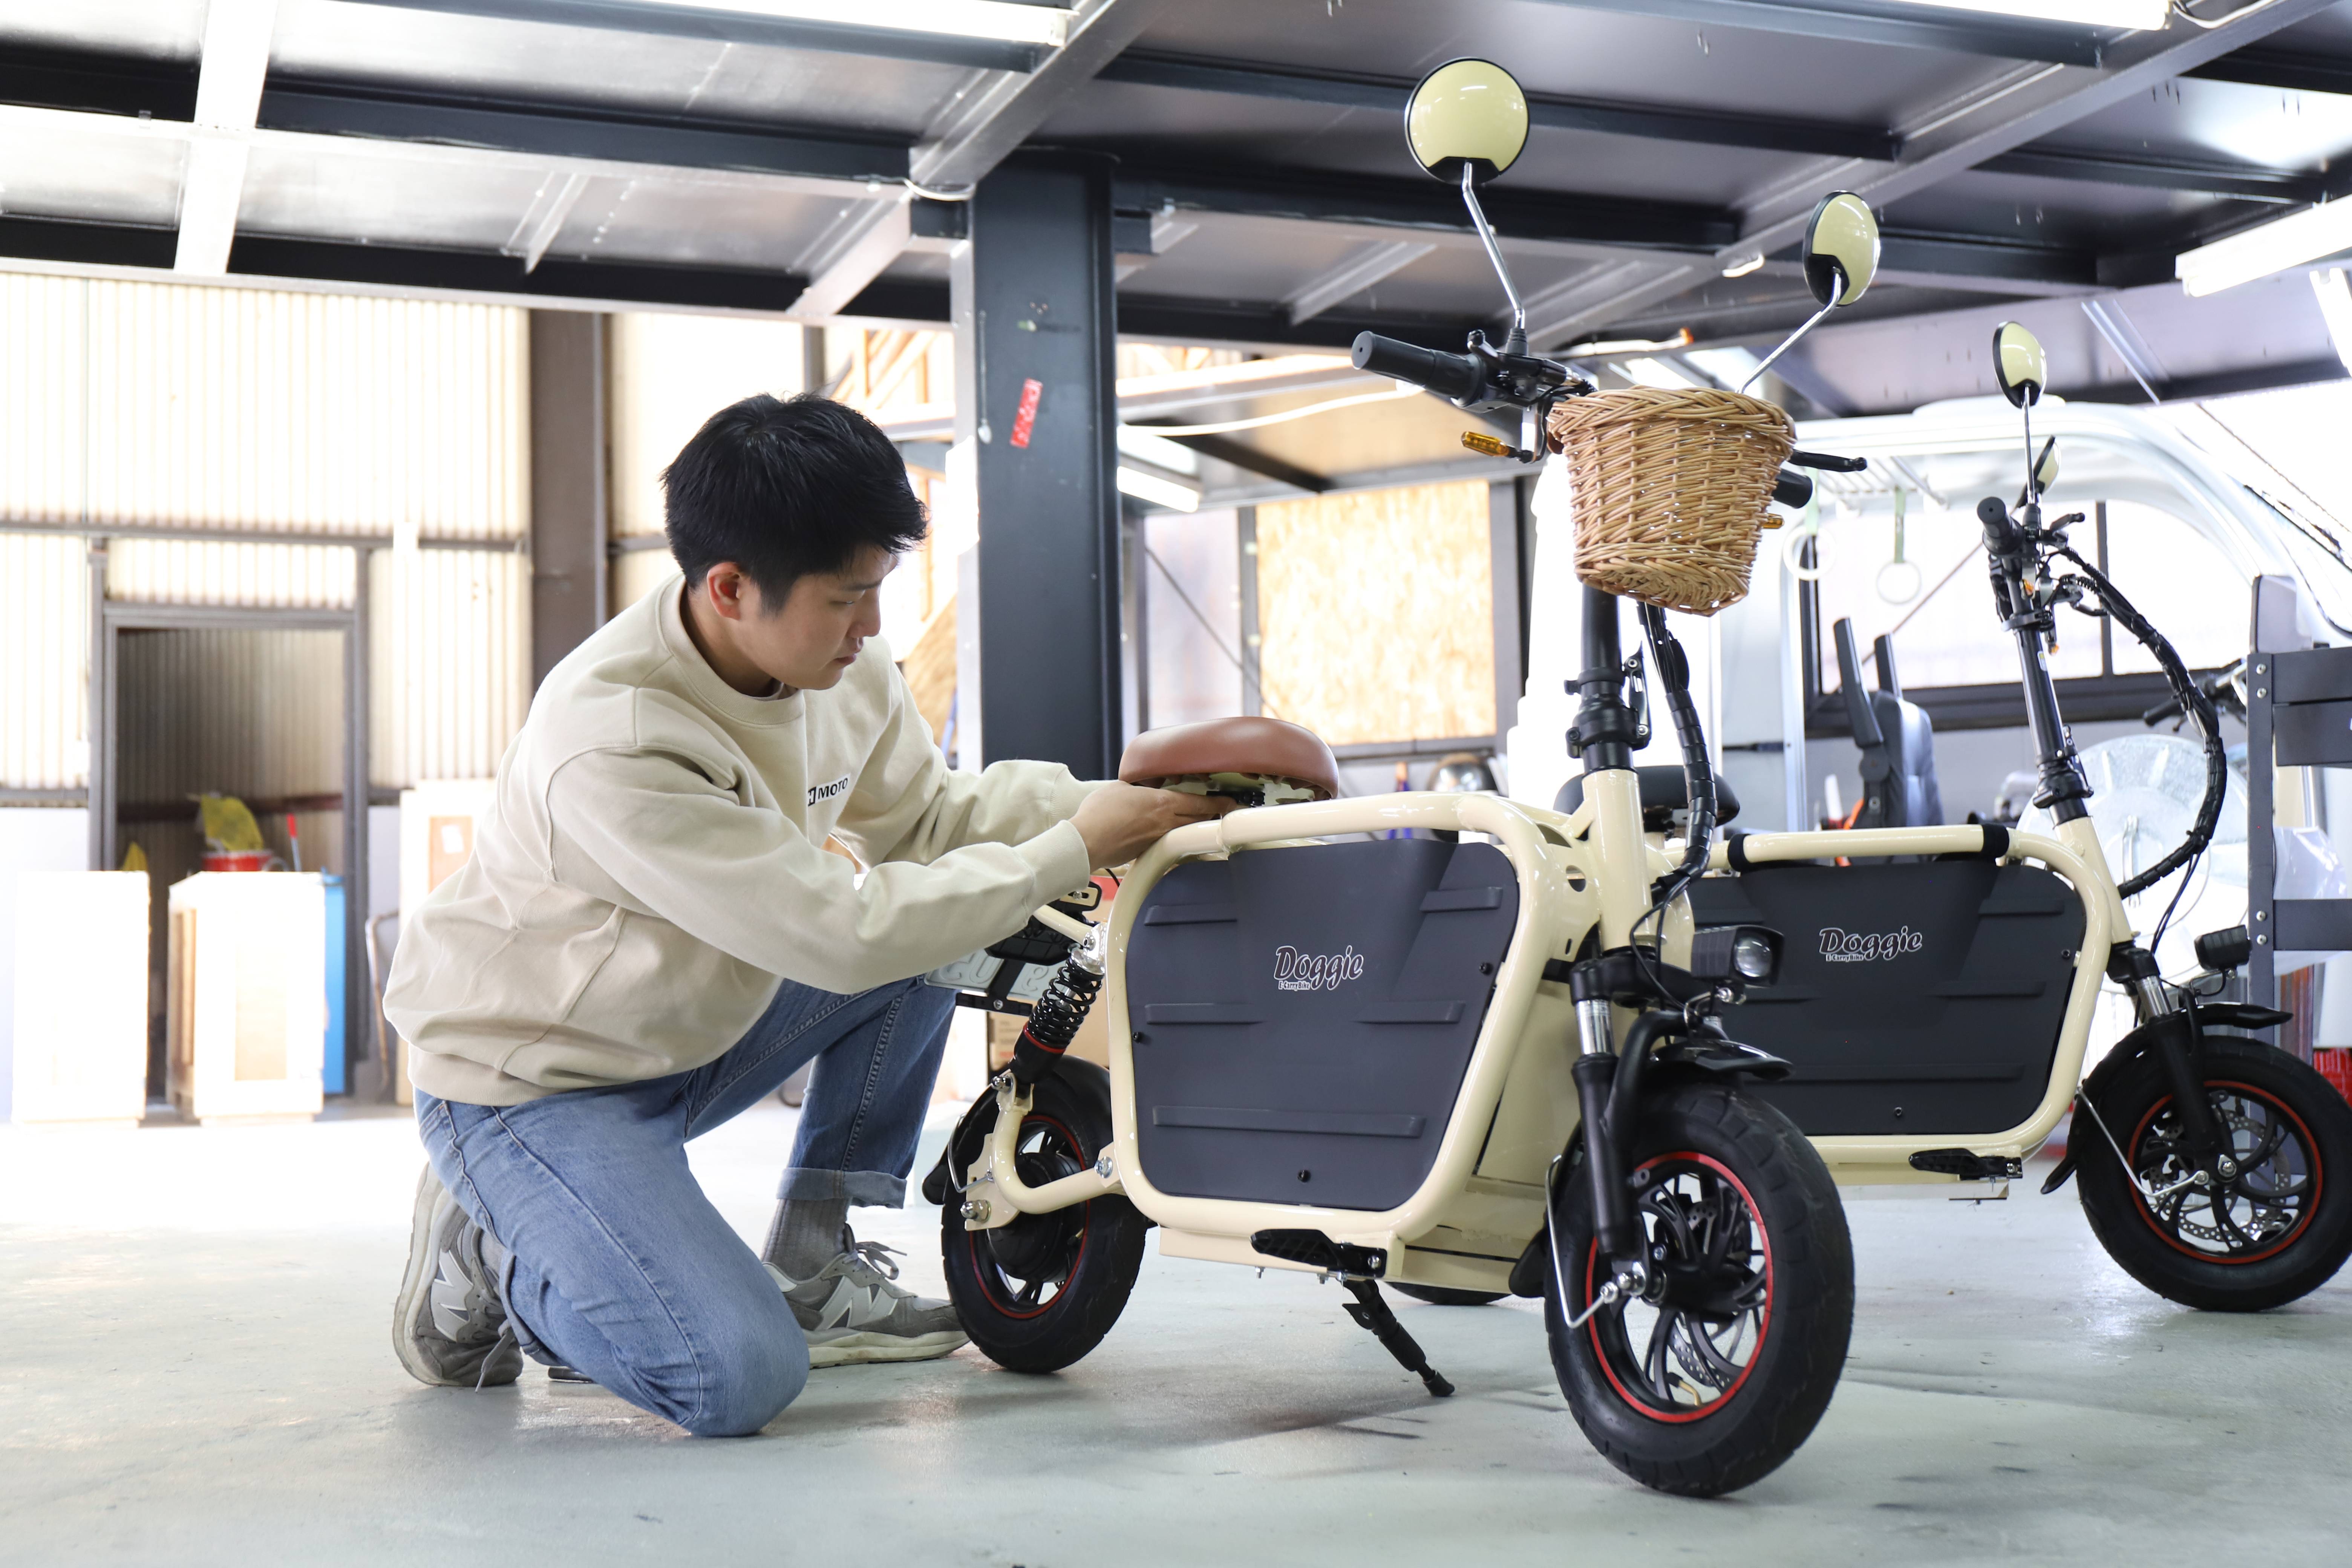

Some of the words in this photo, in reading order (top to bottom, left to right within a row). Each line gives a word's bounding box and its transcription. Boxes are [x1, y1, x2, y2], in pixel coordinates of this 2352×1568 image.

[818, 778, 848, 799] MOTO
[1819, 925, 1923, 961] Doggie
[1274, 945, 1364, 991] Doggie
